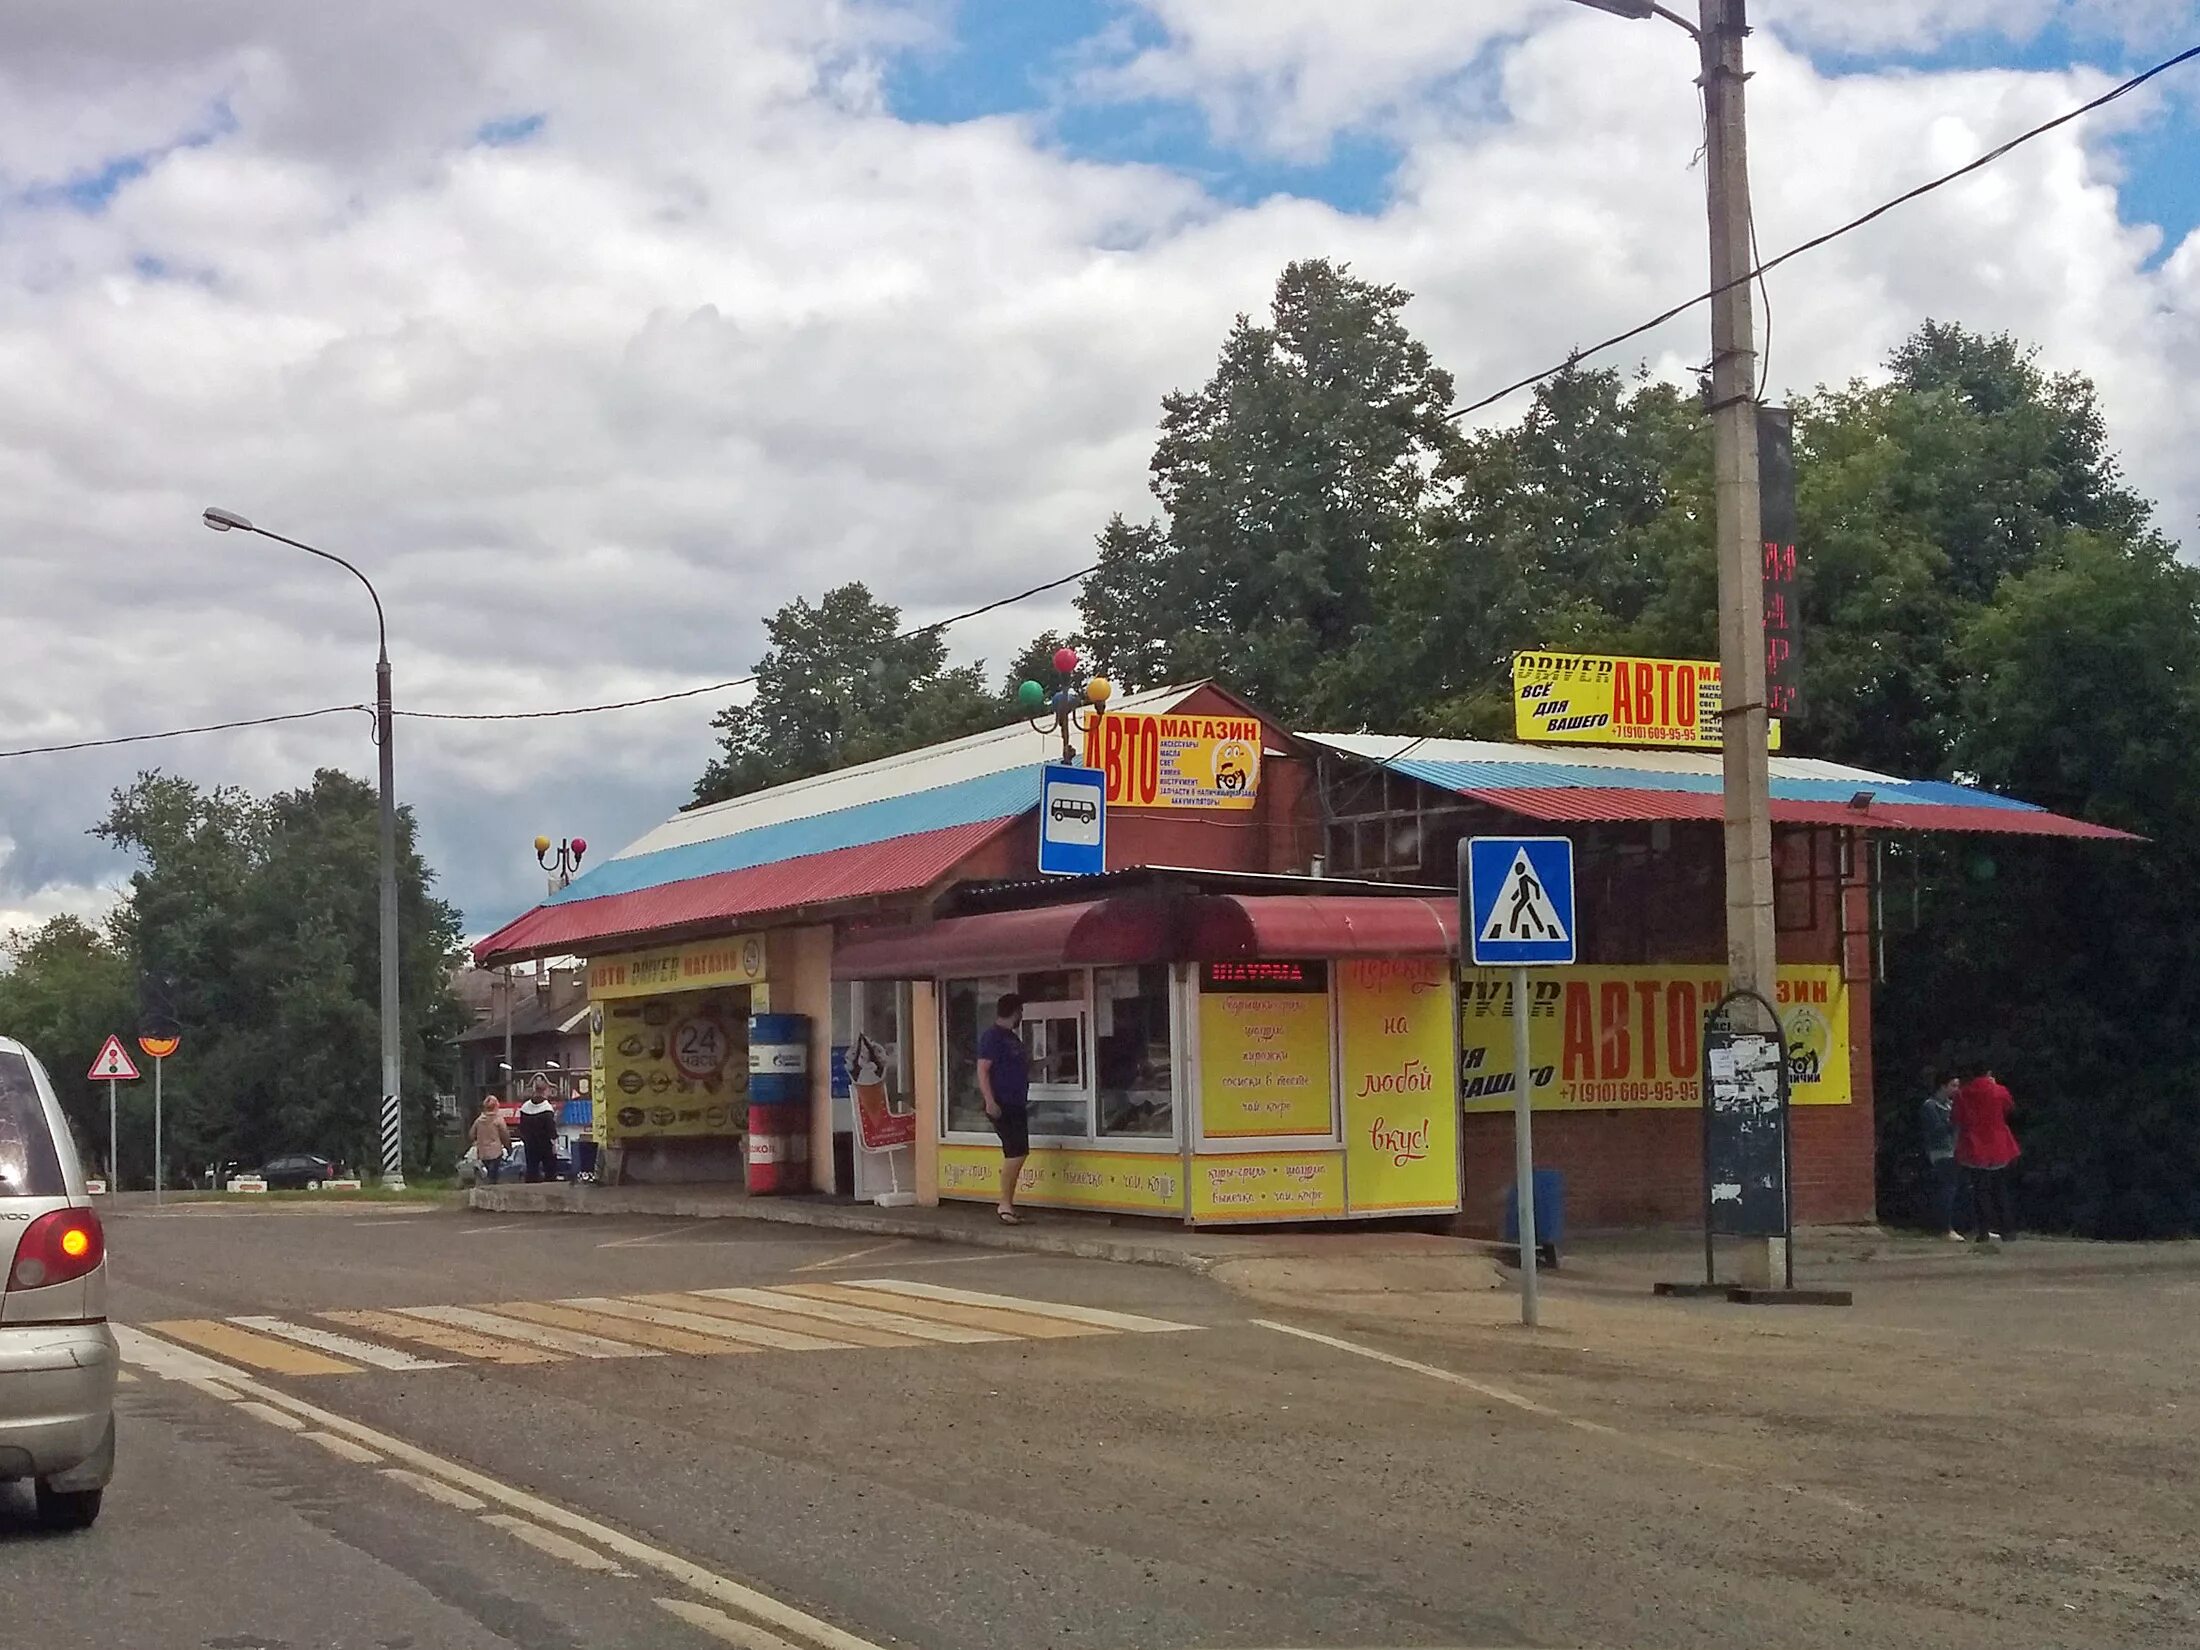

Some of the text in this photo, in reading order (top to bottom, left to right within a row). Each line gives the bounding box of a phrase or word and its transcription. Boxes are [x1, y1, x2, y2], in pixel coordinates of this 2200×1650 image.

[1517, 656, 1613, 684] DRIVER
[1613, 662, 1695, 727] АВТО
[1532, 700, 1569, 718] ДЛЯ
[1547, 714, 1609, 732] ВАШЕГО
[1160, 719, 1257, 740] МАГАЗИН
[1612, 726, 1621, 738] +7
[1648, 727, 1696, 741] 609-95-95
[1086, 715, 1158, 804] АВТО
[1384, 1016, 1409, 1035] на
[1562, 981, 1698, 1080] АВТО
[682, 1026, 715, 1054] 24
[1356, 1060, 1432, 1098] любой
[1560, 1083, 1576, 1102] +7
[1620, 1081, 1699, 1101] 609-95-95
[1368, 1116, 1430, 1168] вкус!
[1148, 1172, 1175, 1204] кое
